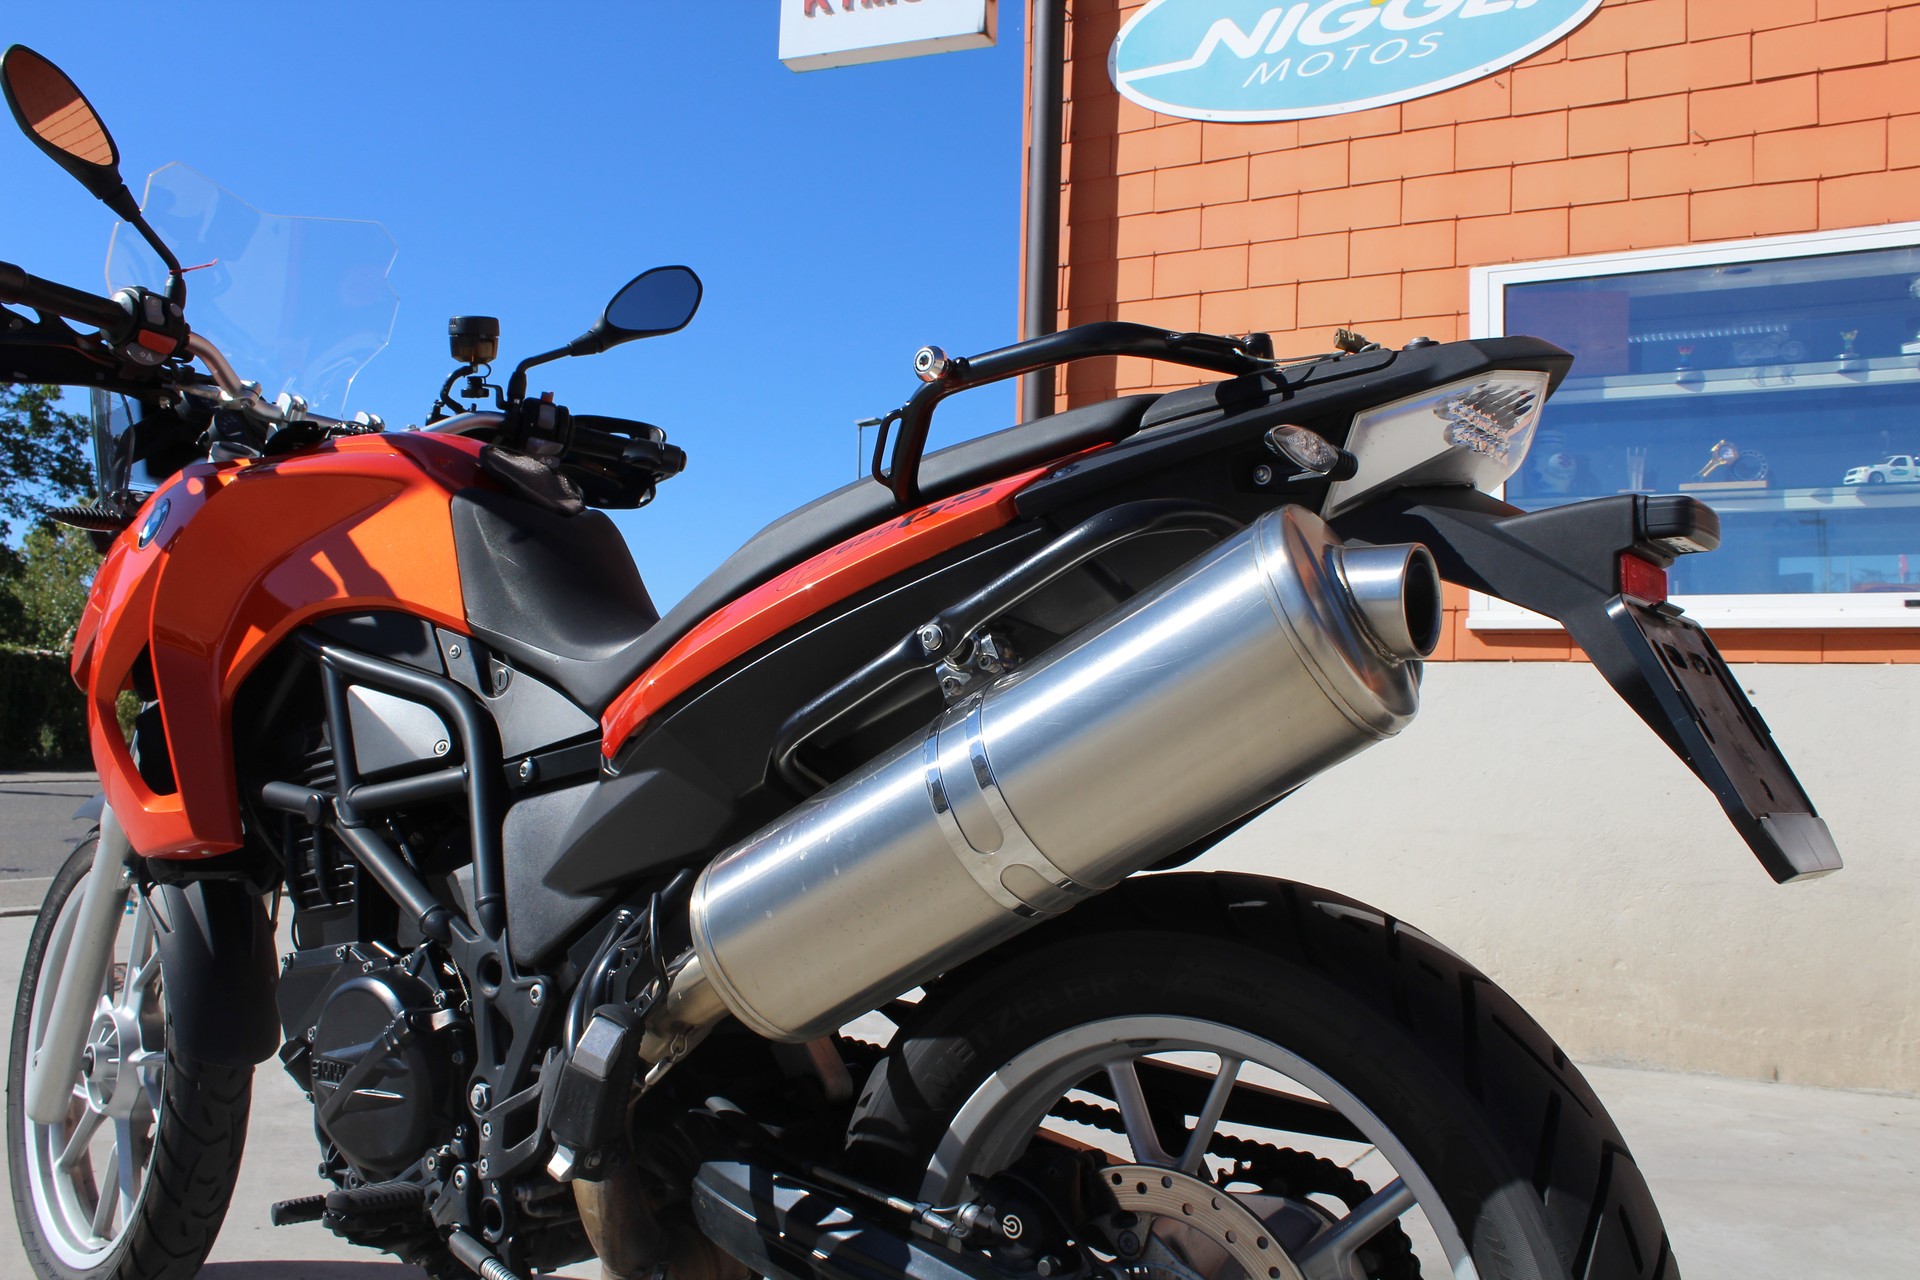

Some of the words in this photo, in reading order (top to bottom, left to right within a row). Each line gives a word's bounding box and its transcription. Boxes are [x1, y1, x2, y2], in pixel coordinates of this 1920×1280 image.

[1188, 0, 1538, 68] NIGGL
[1242, 31, 1444, 89] MOTOS
[311, 1058, 346, 1082] BMW
[921, 971, 1118, 1108] METZELER
